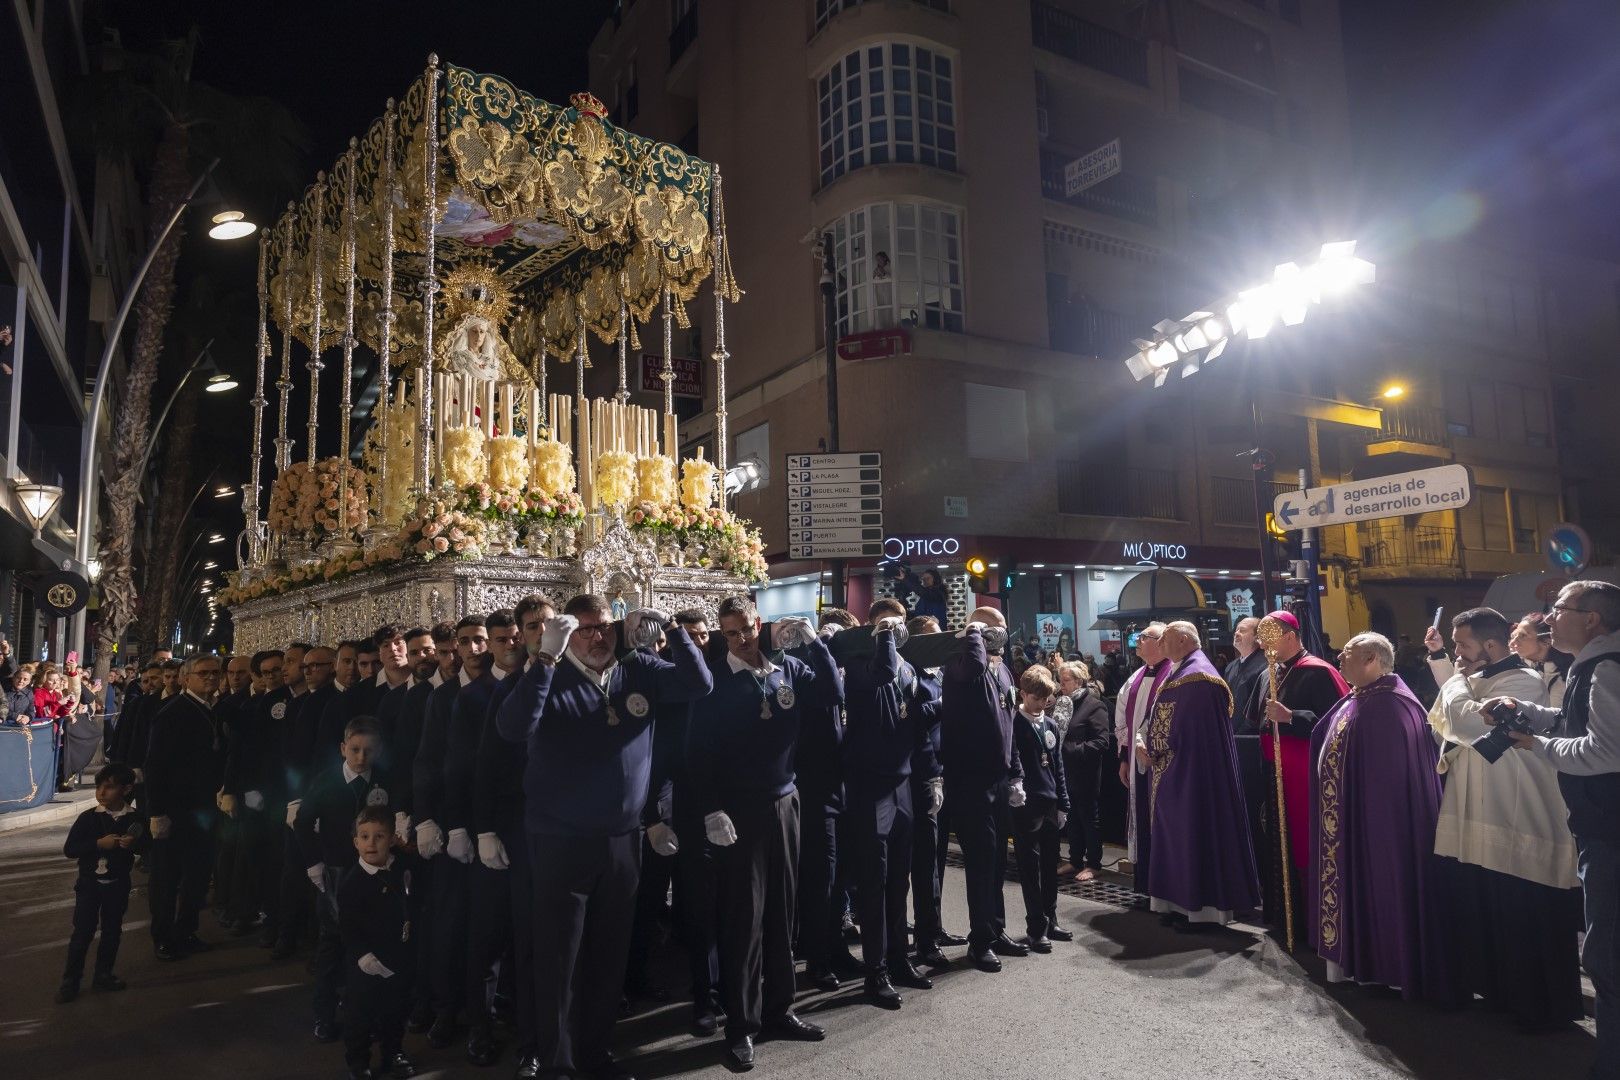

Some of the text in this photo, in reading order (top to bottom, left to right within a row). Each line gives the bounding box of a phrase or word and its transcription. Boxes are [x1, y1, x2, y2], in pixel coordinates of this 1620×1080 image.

[1077, 143, 1118, 172] ASESORIA
[1067, 158, 1118, 193] TORREVIEJA
[685, 361, 697, 372] DE
[1343, 478, 1426, 501] agencia de
[1344, 487, 1465, 516] desarrollo local
[1043, 622, 1060, 634] 50%
